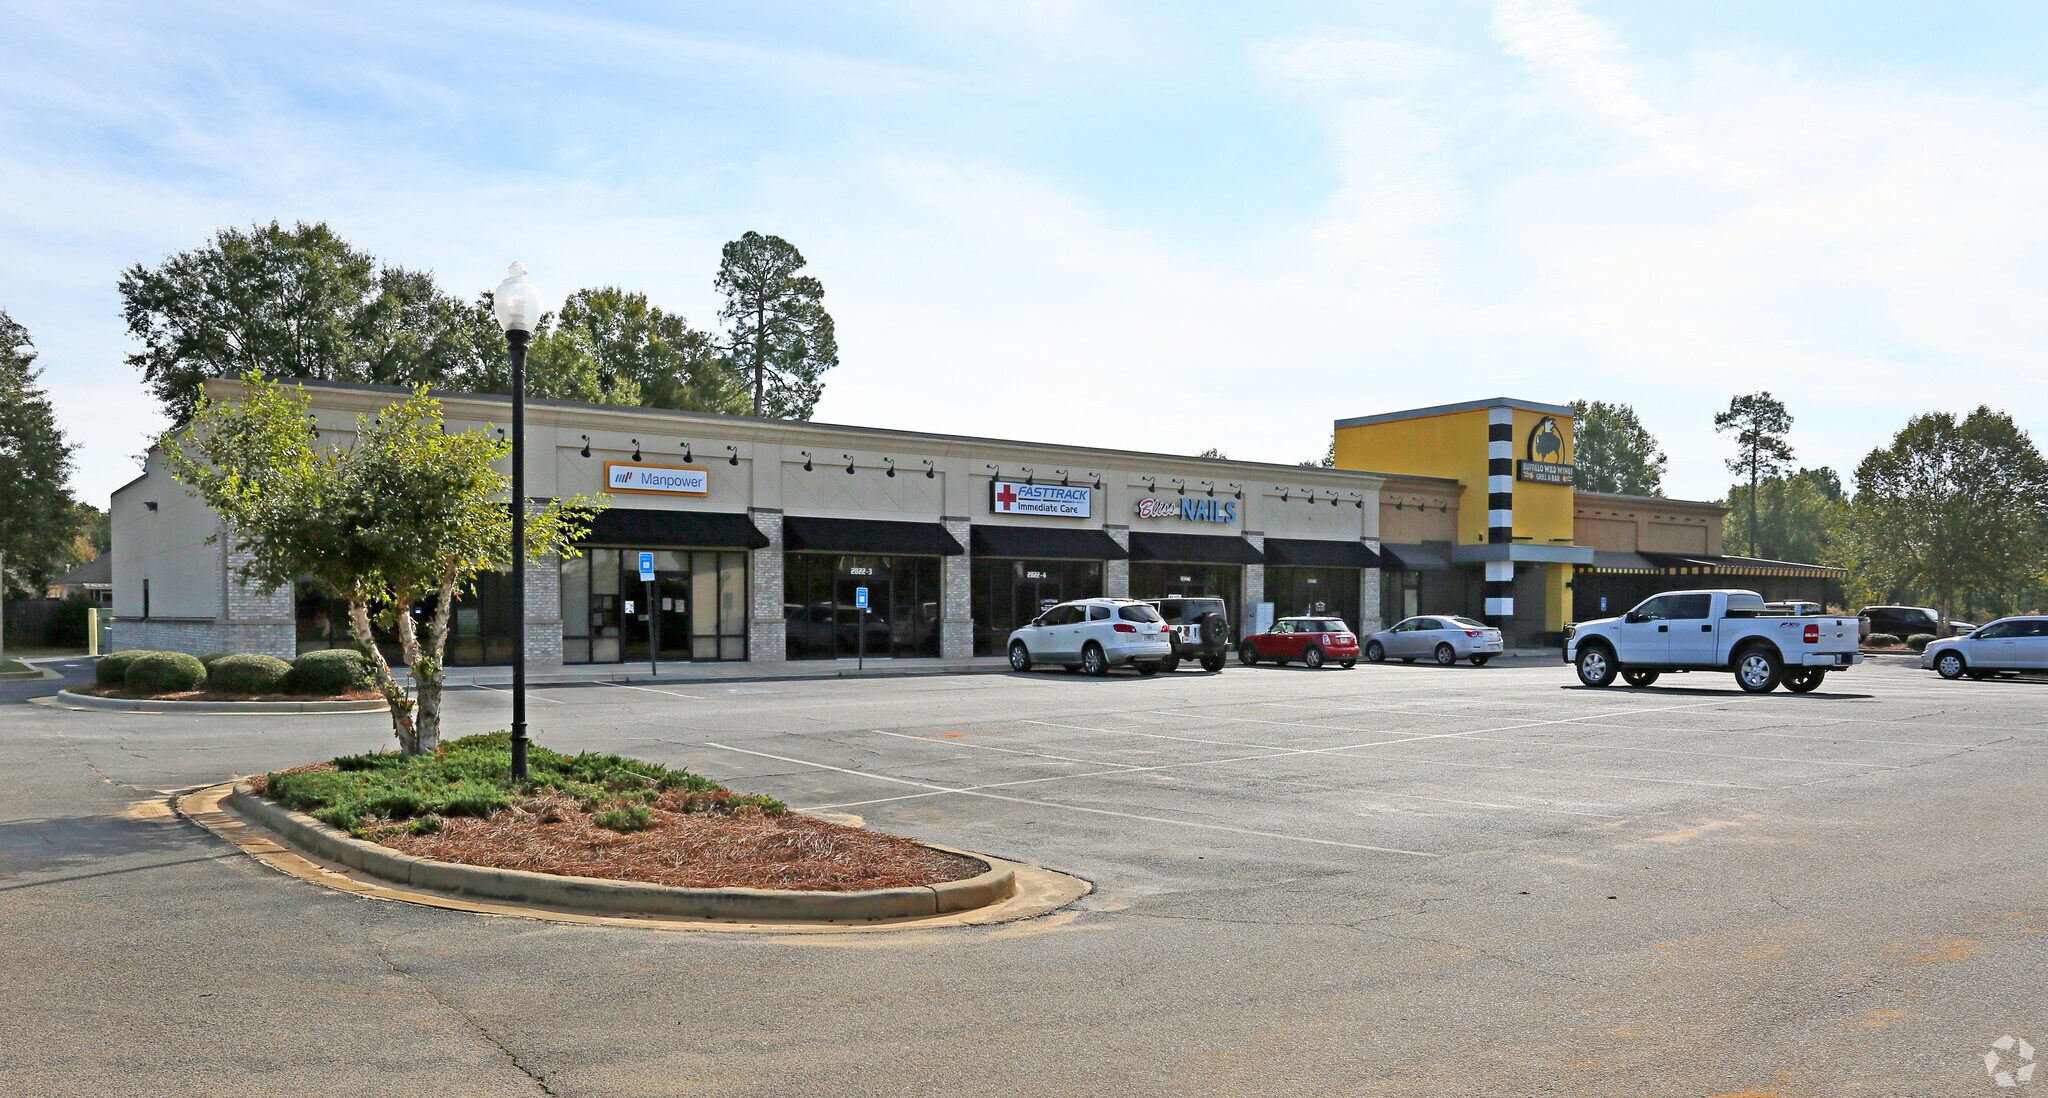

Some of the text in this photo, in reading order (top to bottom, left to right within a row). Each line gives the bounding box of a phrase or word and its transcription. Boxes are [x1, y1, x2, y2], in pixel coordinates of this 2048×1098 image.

[1523, 463, 1573, 475] BUFFALO WILD WINGS
[641, 472, 702, 488] Manpower
[1018, 486, 1087, 500] FASTTRACK
[1018, 502, 1078, 513] Immediate Care
[1139, 498, 1237, 524] Bliss NAILS
[850, 567, 873, 575] 2022-3
[1027, 571, 1047, 579] 2022-4
